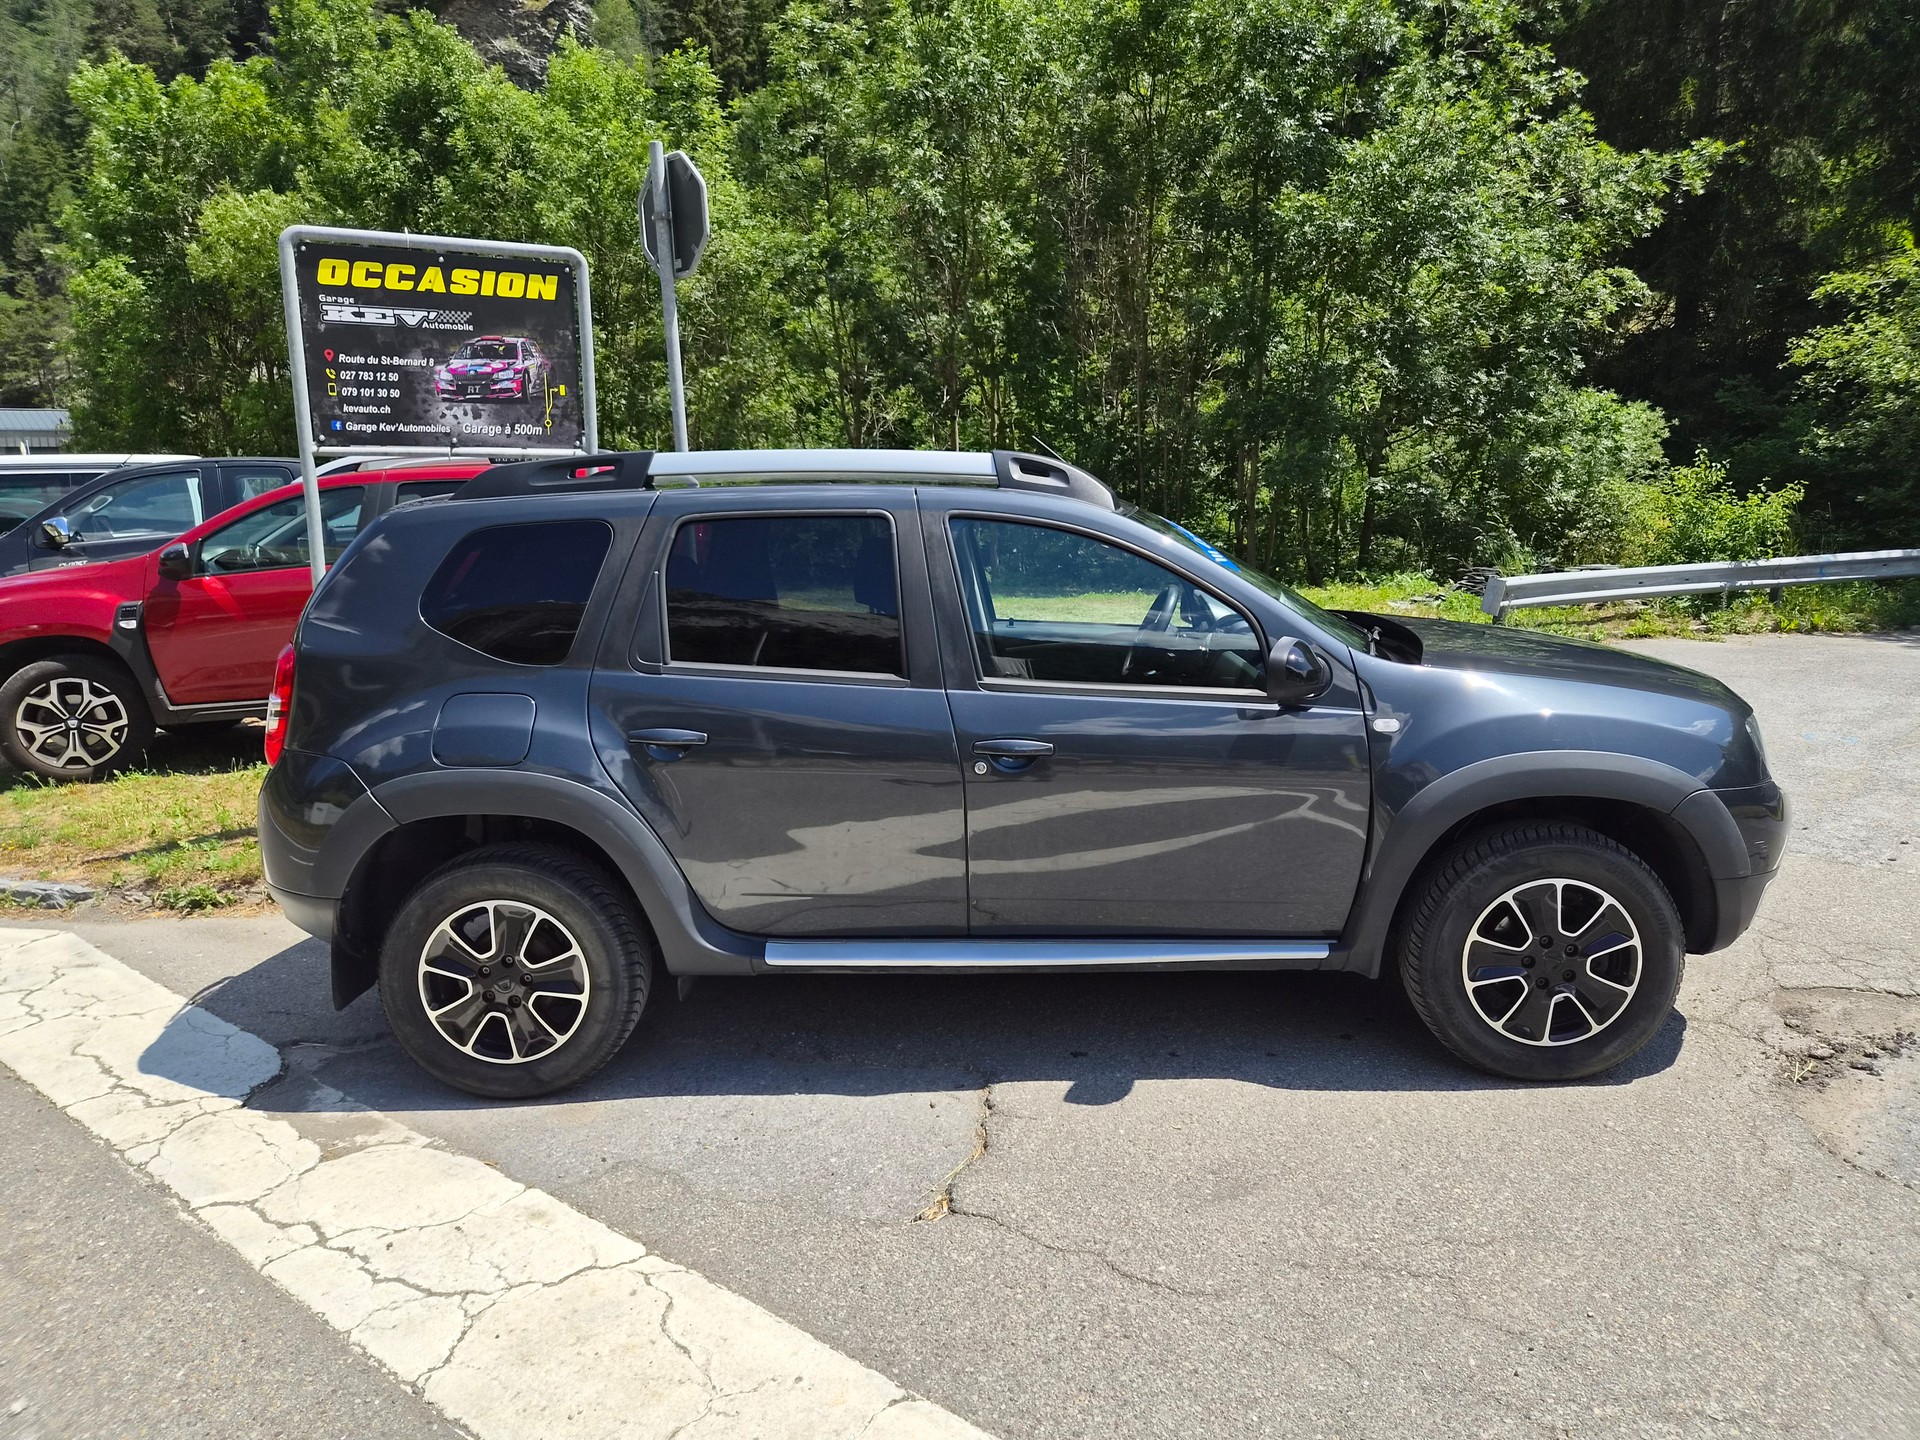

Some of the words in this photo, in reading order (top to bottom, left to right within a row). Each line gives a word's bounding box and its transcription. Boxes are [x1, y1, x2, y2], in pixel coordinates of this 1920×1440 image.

[317, 258, 558, 300] OCCASION
[319, 294, 354, 304] Garage
[422, 321, 473, 331] Automobile
[339, 354, 364, 365] Route
[367, 355, 378, 365] du
[380, 356, 427, 366] St-Bernard
[429, 358, 434, 366] 8
[340, 371, 356, 381] 027
[358, 371, 374, 381] 783
[376, 372, 385, 381] 12
[387, 373, 398, 382] 50
[341, 387, 358, 397] 079
[360, 388, 375, 397] 101
[377, 388, 388, 398] 30
[390, 389, 400, 398] 50
[343, 403, 391, 414] kevauto.ch
[345, 422, 377, 433] Garage
[379, 423, 450, 434] Kev'Automobiles
[462, 423, 502, 436] Garage
[504, 424, 511, 435] à
[514, 425, 543, 435] 500m
